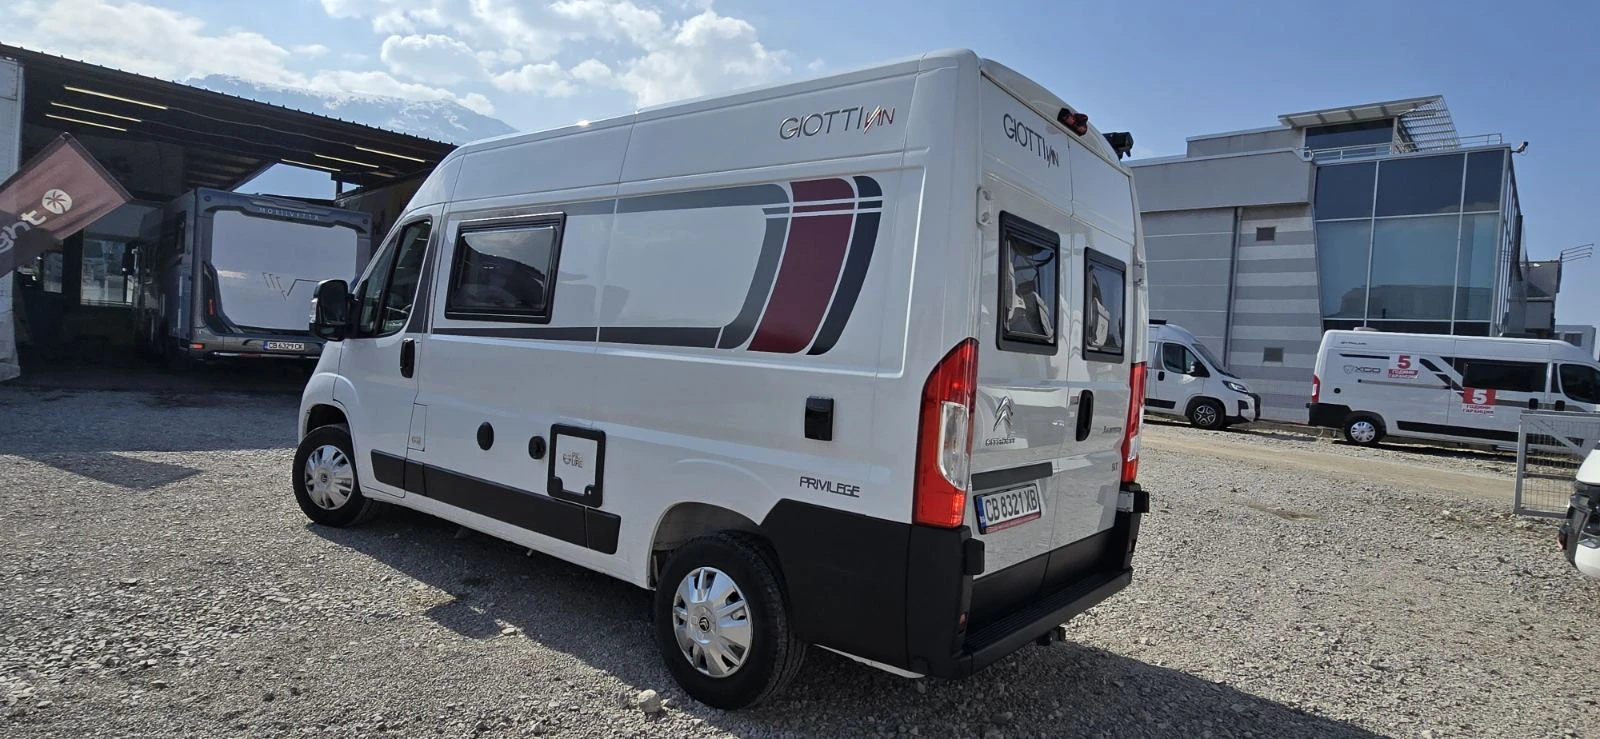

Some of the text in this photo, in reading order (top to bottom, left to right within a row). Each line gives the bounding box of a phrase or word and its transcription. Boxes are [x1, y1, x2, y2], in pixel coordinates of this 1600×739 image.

[1397, 354, 1411, 369] 5
[1472, 388, 1488, 405] 5
[799, 476, 860, 498] PRIVILEGE
[985, 489, 1038, 522] CB 8321 XB
